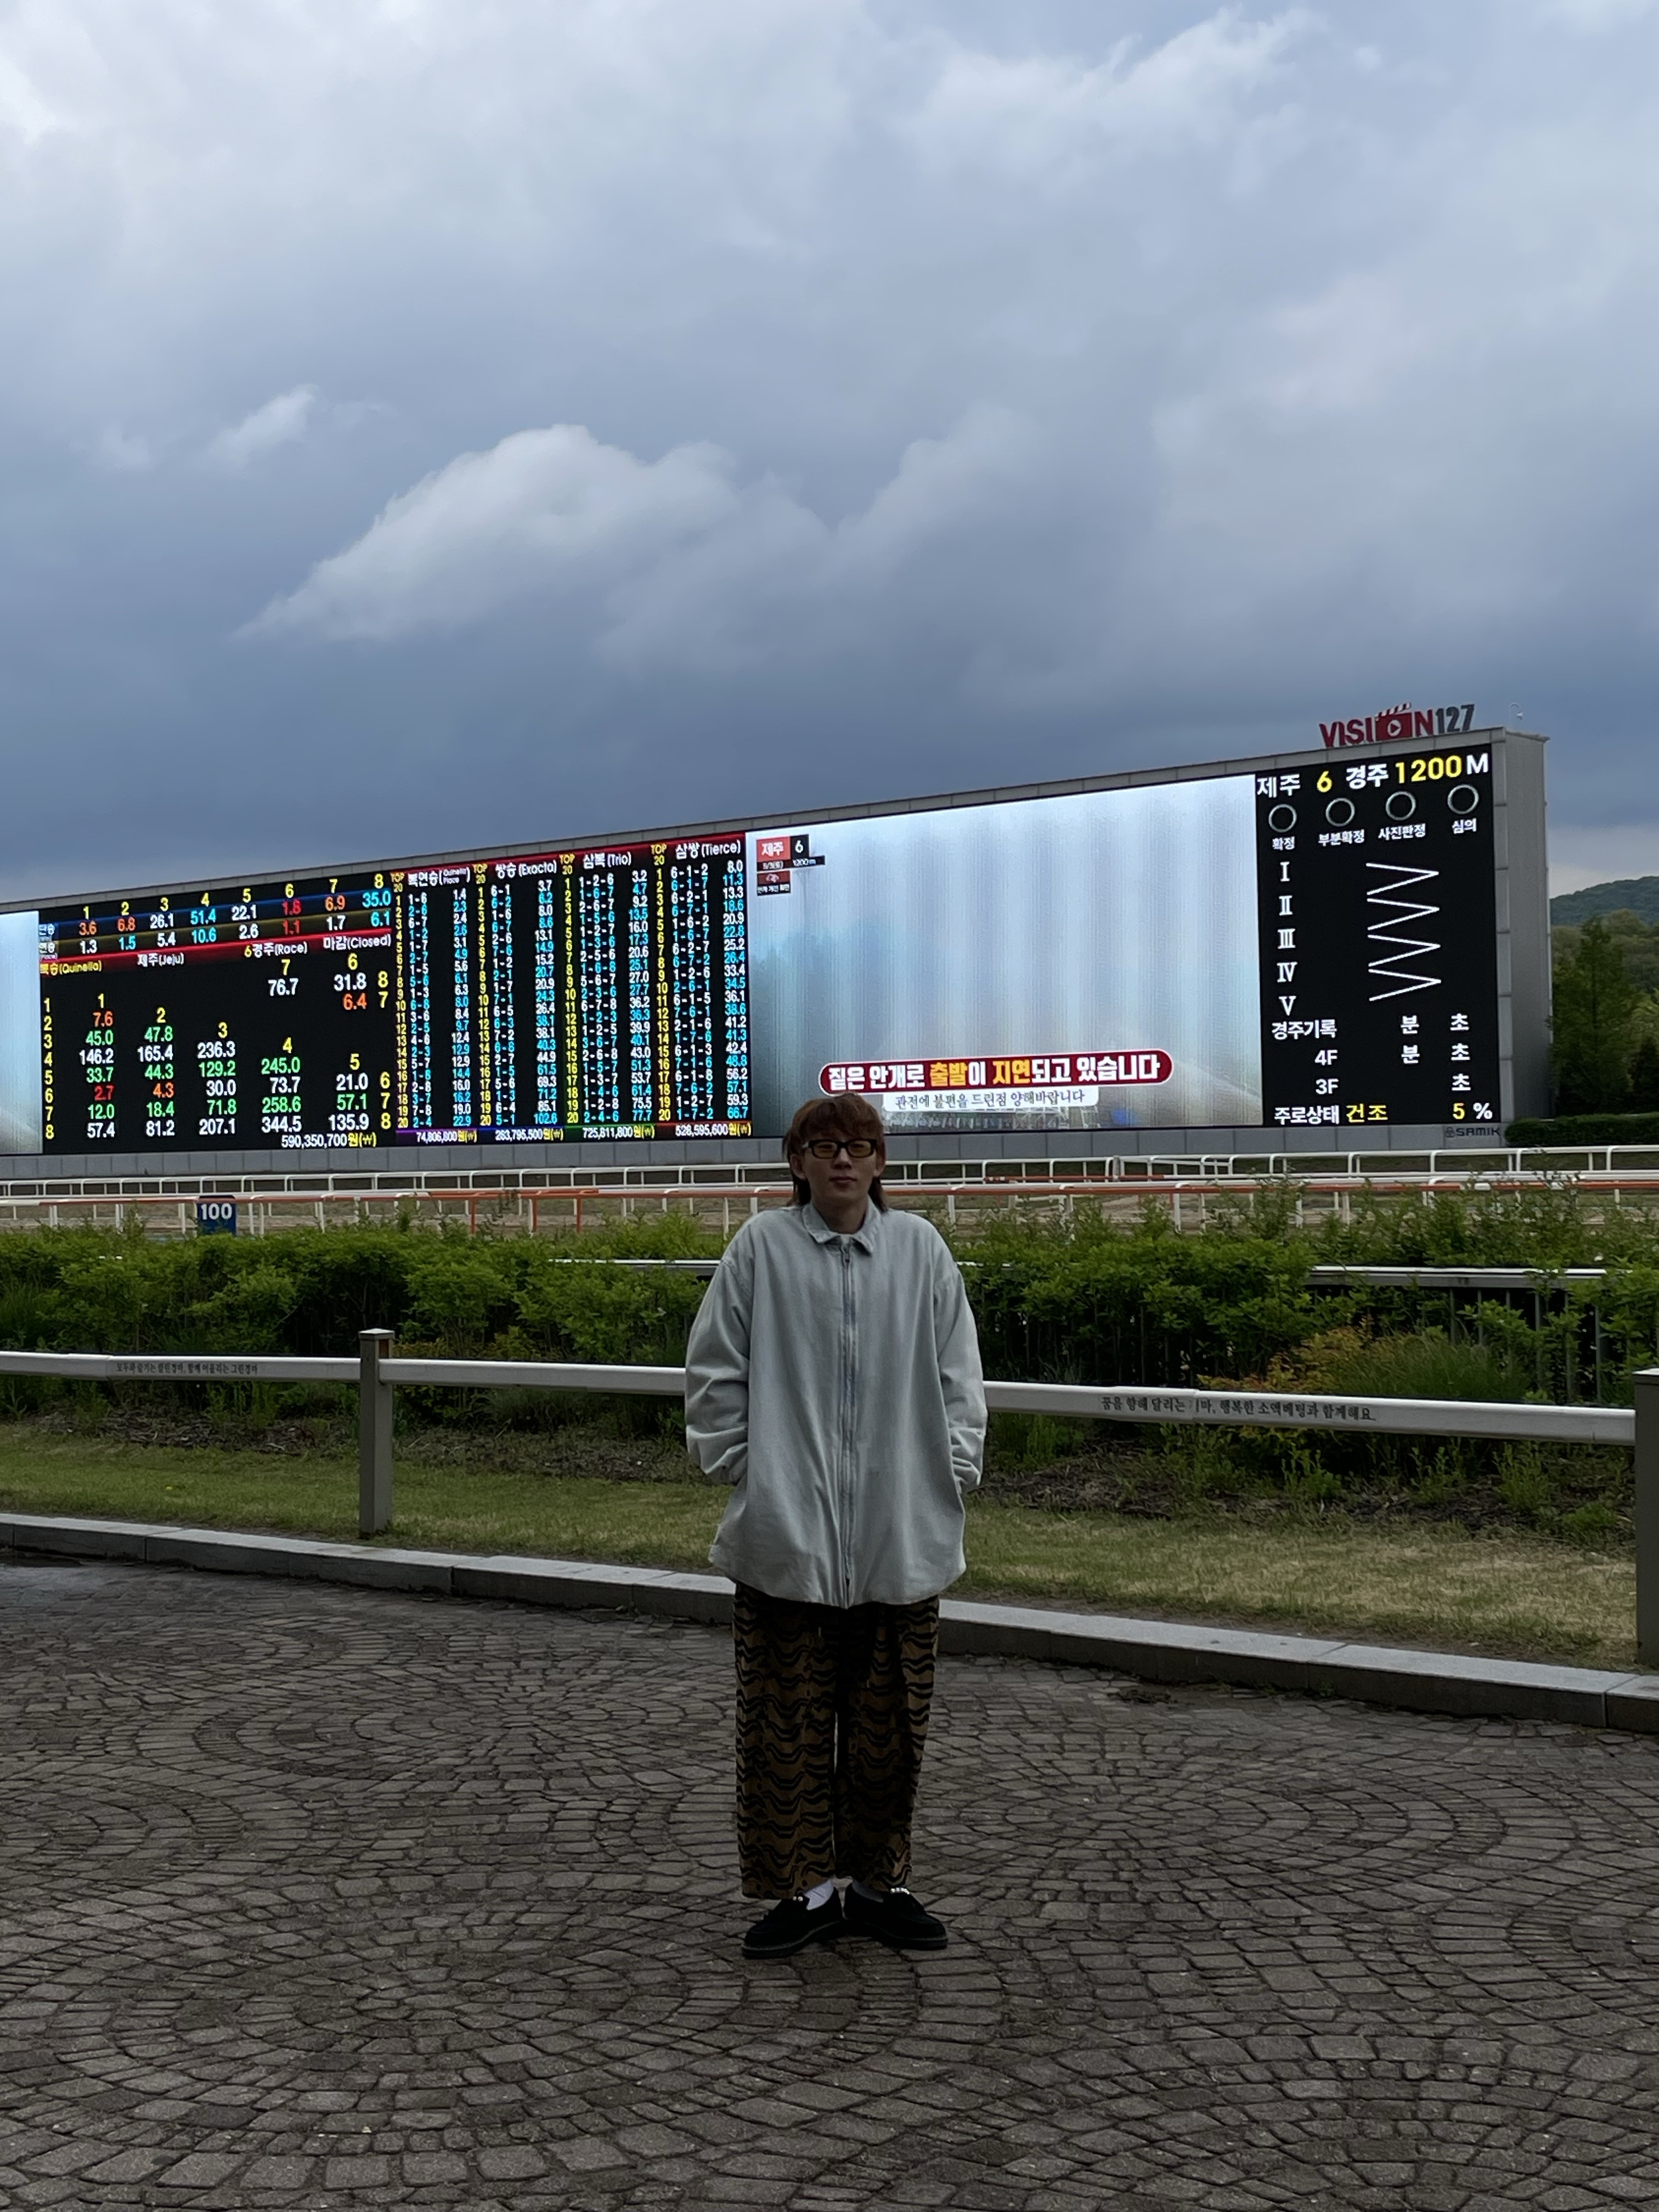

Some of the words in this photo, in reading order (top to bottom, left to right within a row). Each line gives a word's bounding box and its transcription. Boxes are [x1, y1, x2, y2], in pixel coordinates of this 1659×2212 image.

[1257, 774, 1301, 798] 제주
[1317, 771, 1332, 792] 6
[1346, 763, 1389, 790] 경주
[1378, 823, 1426, 840] 사진판정
[1452, 818, 1477, 834] 심의
[761, 841, 784, 857] 제주
[795, 840, 804, 853] 6
[727, 860, 743, 873] 8.0
[83, 906, 89, 919] 1
[121, 901, 129, 916] 2
[160, 898, 168, 911] 3
[201, 893, 210, 907] 4
[242, 888, 251, 902] 5
[285, 883, 294, 898] 6
[329, 878, 338, 893] 7
[374, 874, 383, 889] 8
[723, 886, 743, 899] 13.3
[79, 921, 97, 935] 3.6
[117, 916, 136, 932] 6.8
[150, 913, 174, 929] 26.1
[190, 909, 216, 925] 51.4
[232, 904, 256, 921] 22.1
[325, 895, 345, 911] 6.9
[362, 891, 391, 908] 35.0
[80, 939, 97, 954] 1.3
[119, 935, 137, 950] 1.5
[157, 932, 176, 947] 5.4
[191, 927, 216, 943] 10.6
[239, 923, 259, 940] 2.6
[326, 915, 346, 931] 1.7
[371, 910, 390, 927] 6.1
[281, 959, 290, 975] 7
[348, 954, 358, 970] 6
[268, 978, 298, 996] 76.7
[334, 972, 367, 991] 31.8
[378, 971, 388, 988] 8
[44, 997, 50, 1013] 1
[98, 994, 104, 1008] 1
[343, 992, 367, 1010] 6.4
[378, 991, 388, 1008] 7
[1278, 995, 1296, 1016] V
[44, 1015, 52, 1031] 2
[93, 1011, 113, 1027] 7.6
[157, 1007, 166, 1023] 2
[725, 1016, 746, 1029] 41.2
[1271, 1019, 1337, 1040] 경주기록
[1400, 1015, 1420, 1035] 분
[1450, 1013, 1469, 1031] 초
[43, 1034, 53, 1049] 3
[86, 1030, 114, 1046] 45.0
[144, 1025, 173, 1042] 47.8
[218, 1022, 228, 1039] 3
[44, 1052, 53, 1067] 4
[79, 1048, 114, 1065] 146.2
[137, 1044, 173, 1062] 165.4
[197, 1041, 235, 1059] 236.3
[283, 1037, 292, 1053] 4
[1314, 1049, 1338, 1066] 4F
[1401, 1045, 1420, 1064] 분
[1451, 1043, 1470, 1061] 초
[44, 1070, 53, 1085] 5
[86, 1066, 114, 1083] 33.7
[144, 1063, 173, 1080] 44.3
[199, 1060, 236, 1077] 129.2
[261, 1057, 300, 1075] 245.0
[349, 1053, 360, 1070] 5
[828, 1066, 865, 1091] 짙은
[869, 1064, 925, 1089] 안개로
[930, 1061, 986, 1087] 출발이
[992, 1058, 1071, 1085] 지연되고
[1077, 1054, 1161, 1082] 있습니다
[45, 1088, 53, 1103] 6
[95, 1085, 114, 1101] 2.7
[153, 1082, 174, 1098] 4.3
[206, 1079, 236, 1097] 30.0
[270, 1076, 301, 1094] 73.7
[336, 1073, 368, 1091] 21.0
[380, 1071, 391, 1089] 6
[1316, 1078, 1339, 1094] 3F
[1452, 1073, 1471, 1091] 초
[45, 1106, 53, 1121] 7
[87, 1103, 115, 1119] 12.0
[146, 1101, 174, 1118] 18.4
[207, 1098, 236, 1115] 71.8
[262, 1096, 301, 1114] 258.6
[337, 1093, 367, 1110] 57.1
[381, 1092, 391, 1109] 7
[971, 1092, 1007, 1107] 드린점
[1010, 1089, 1086, 1107] 양해바랍니다
[1274, 1105, 1340, 1125] 주로상태
[1453, 1103, 1465, 1120] 5
[1473, 1102, 1493, 1119] %
[46, 1124, 54, 1139] 8
[87, 1121, 115, 1138] 57.4
[146, 1119, 175, 1137] 81.2
[199, 1118, 235, 1135] 207.1
[261, 1115, 302, 1133] 344.5
[328, 1113, 369, 1131] 135.9
[381, 1112, 391, 1130] 8
[1455, 1127, 1501, 1137] SAMIK
[201, 1203, 233, 1221] 100
[1151, 1397, 1186, 1413] 달리는
